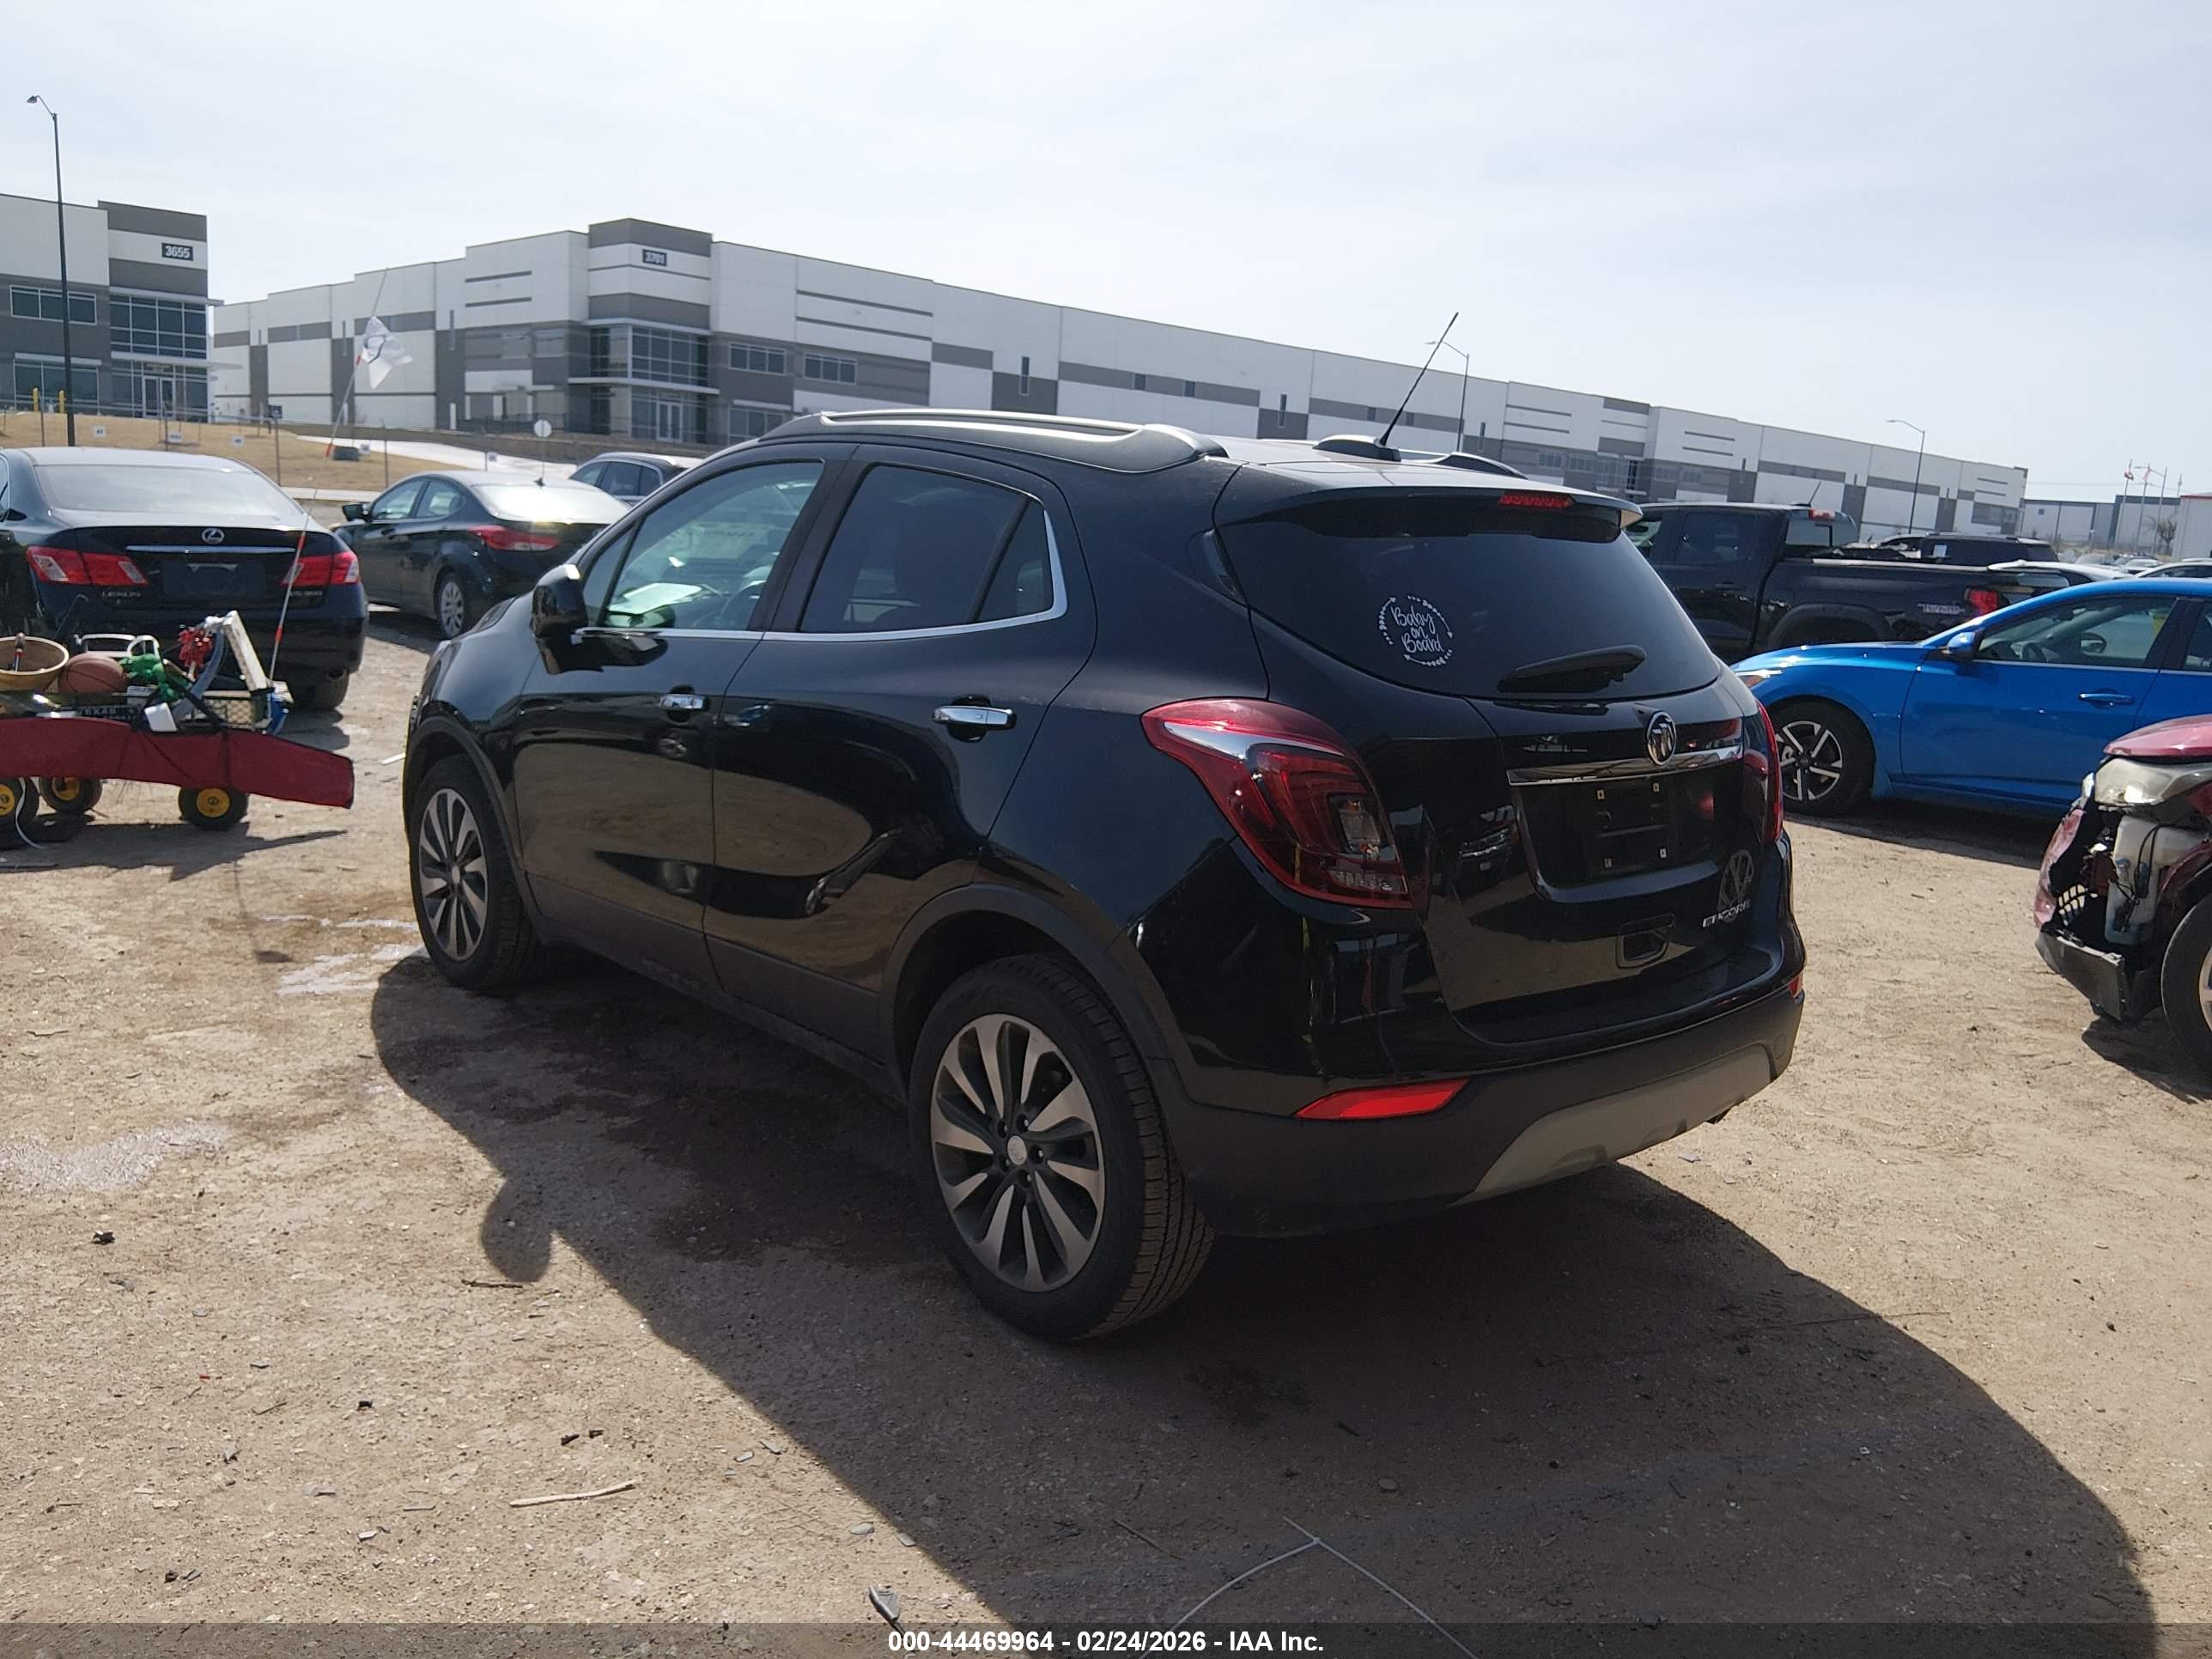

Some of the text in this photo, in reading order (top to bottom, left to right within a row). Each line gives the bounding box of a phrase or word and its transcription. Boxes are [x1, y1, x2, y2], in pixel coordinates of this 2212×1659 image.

[165, 245, 190, 258] 3655
[1391, 605, 1436, 635] Baby
[1410, 626, 1428, 639] on
[1401, 633, 1445, 653] Board
